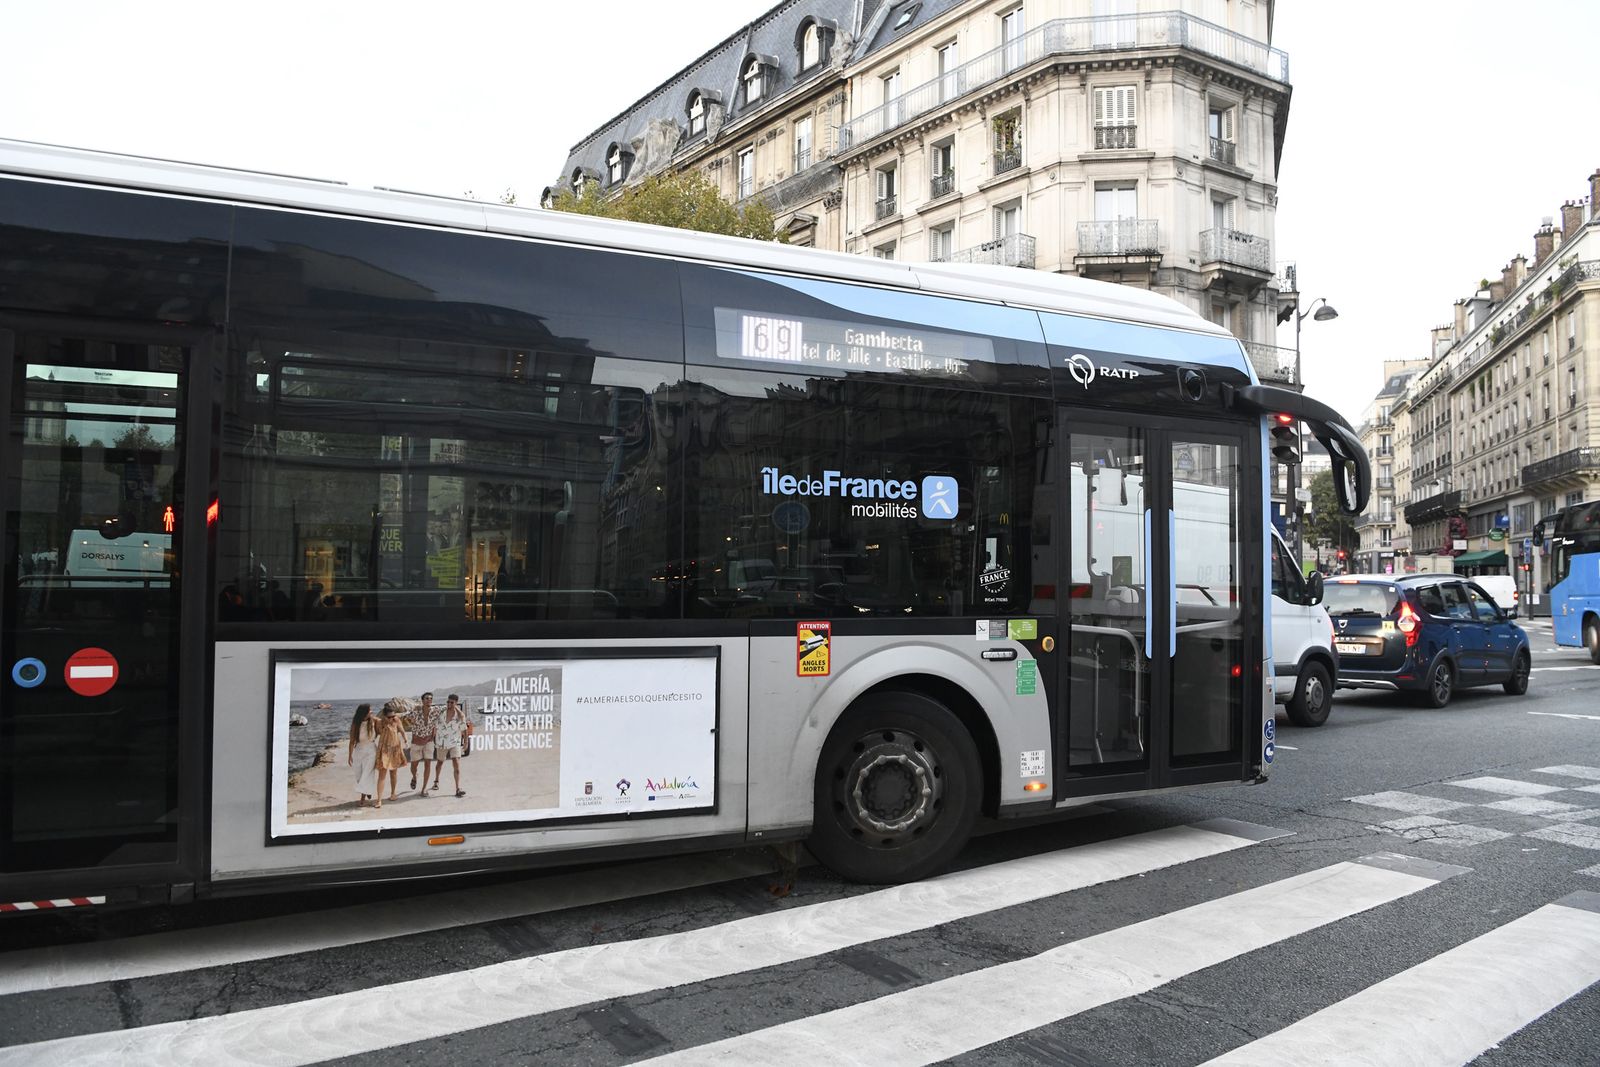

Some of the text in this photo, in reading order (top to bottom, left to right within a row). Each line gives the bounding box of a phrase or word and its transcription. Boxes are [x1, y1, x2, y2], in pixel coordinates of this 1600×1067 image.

[754, 323, 791, 354] 69
[826, 345, 841, 361] de
[1100, 366, 1139, 380] RATP
[851, 502, 918, 519] mobilités
[81, 552, 125, 561] DORSALYS
[980, 570, 1009, 584] FRANCE
[494, 674, 554, 695] ALMERÍA,
[483, 695, 554, 713] LAISSE MOI
[485, 714, 553, 732] RESSENTIR
[468, 732, 553, 751] TON ESSENCE
